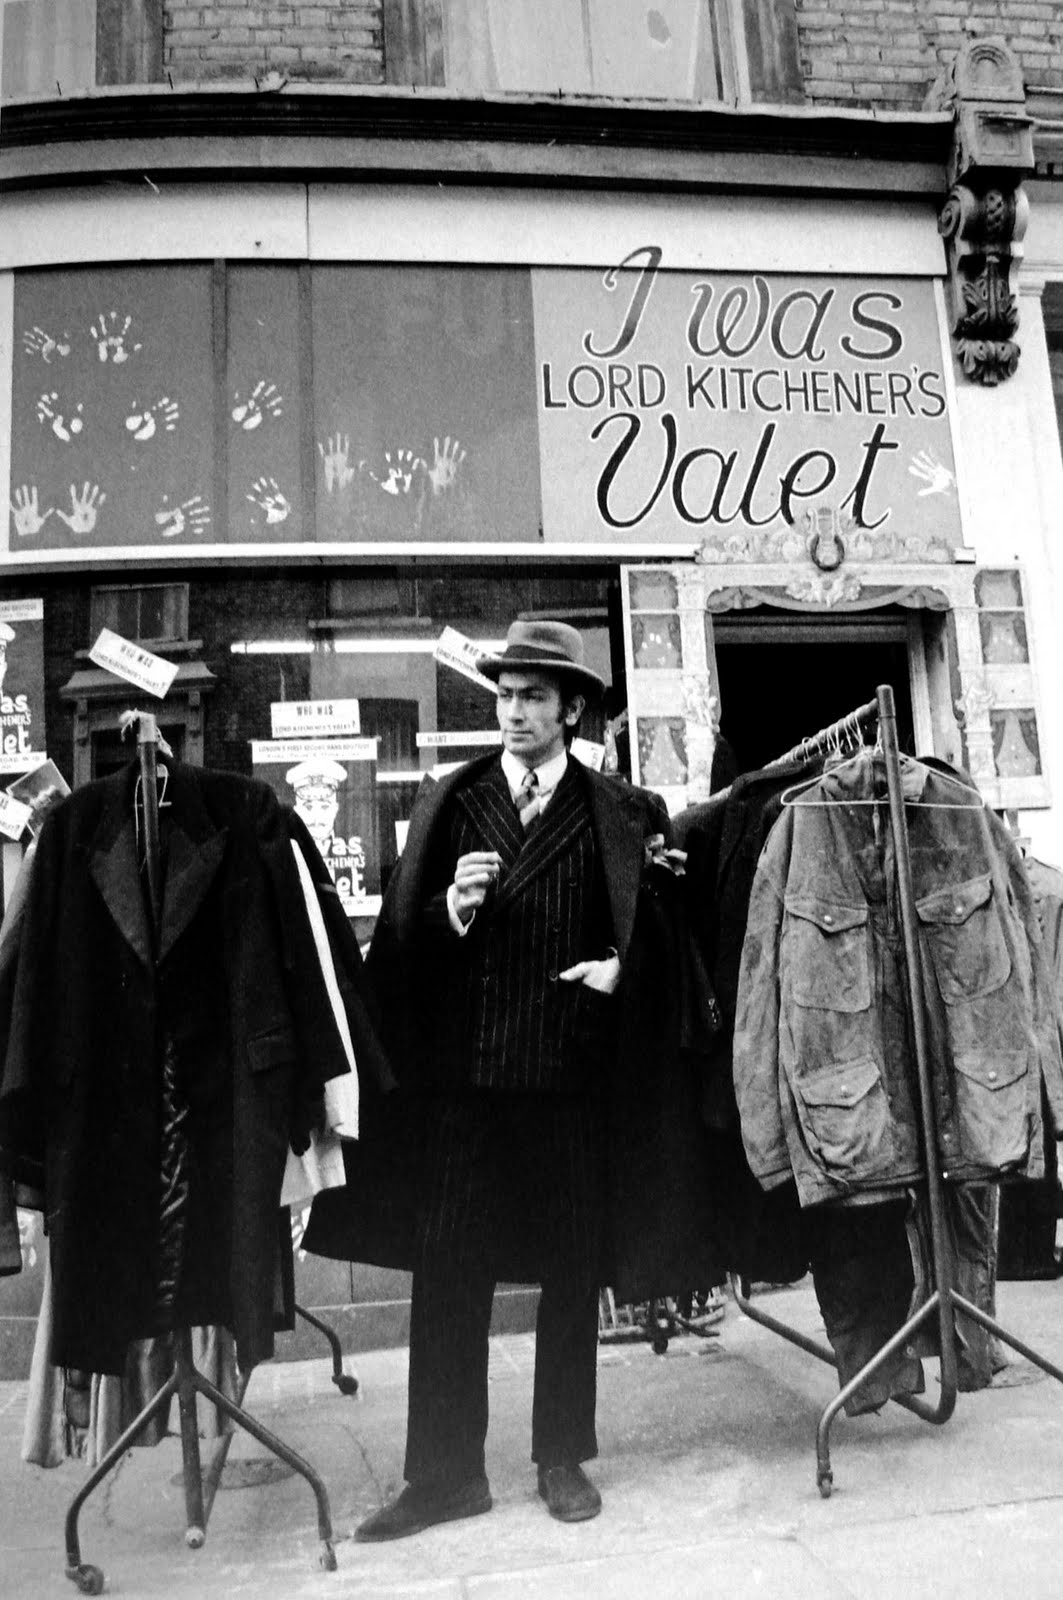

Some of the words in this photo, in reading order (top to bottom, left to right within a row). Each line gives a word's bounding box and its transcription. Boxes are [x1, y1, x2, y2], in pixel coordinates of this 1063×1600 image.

[584, 245, 663, 358] I
[688, 275, 902, 361] was
[542, 363, 666, 409] LORD
[687, 365, 946, 417] KITCHENER'S
[591, 413, 898, 530] Valet
[0, 694, 28, 713] as
